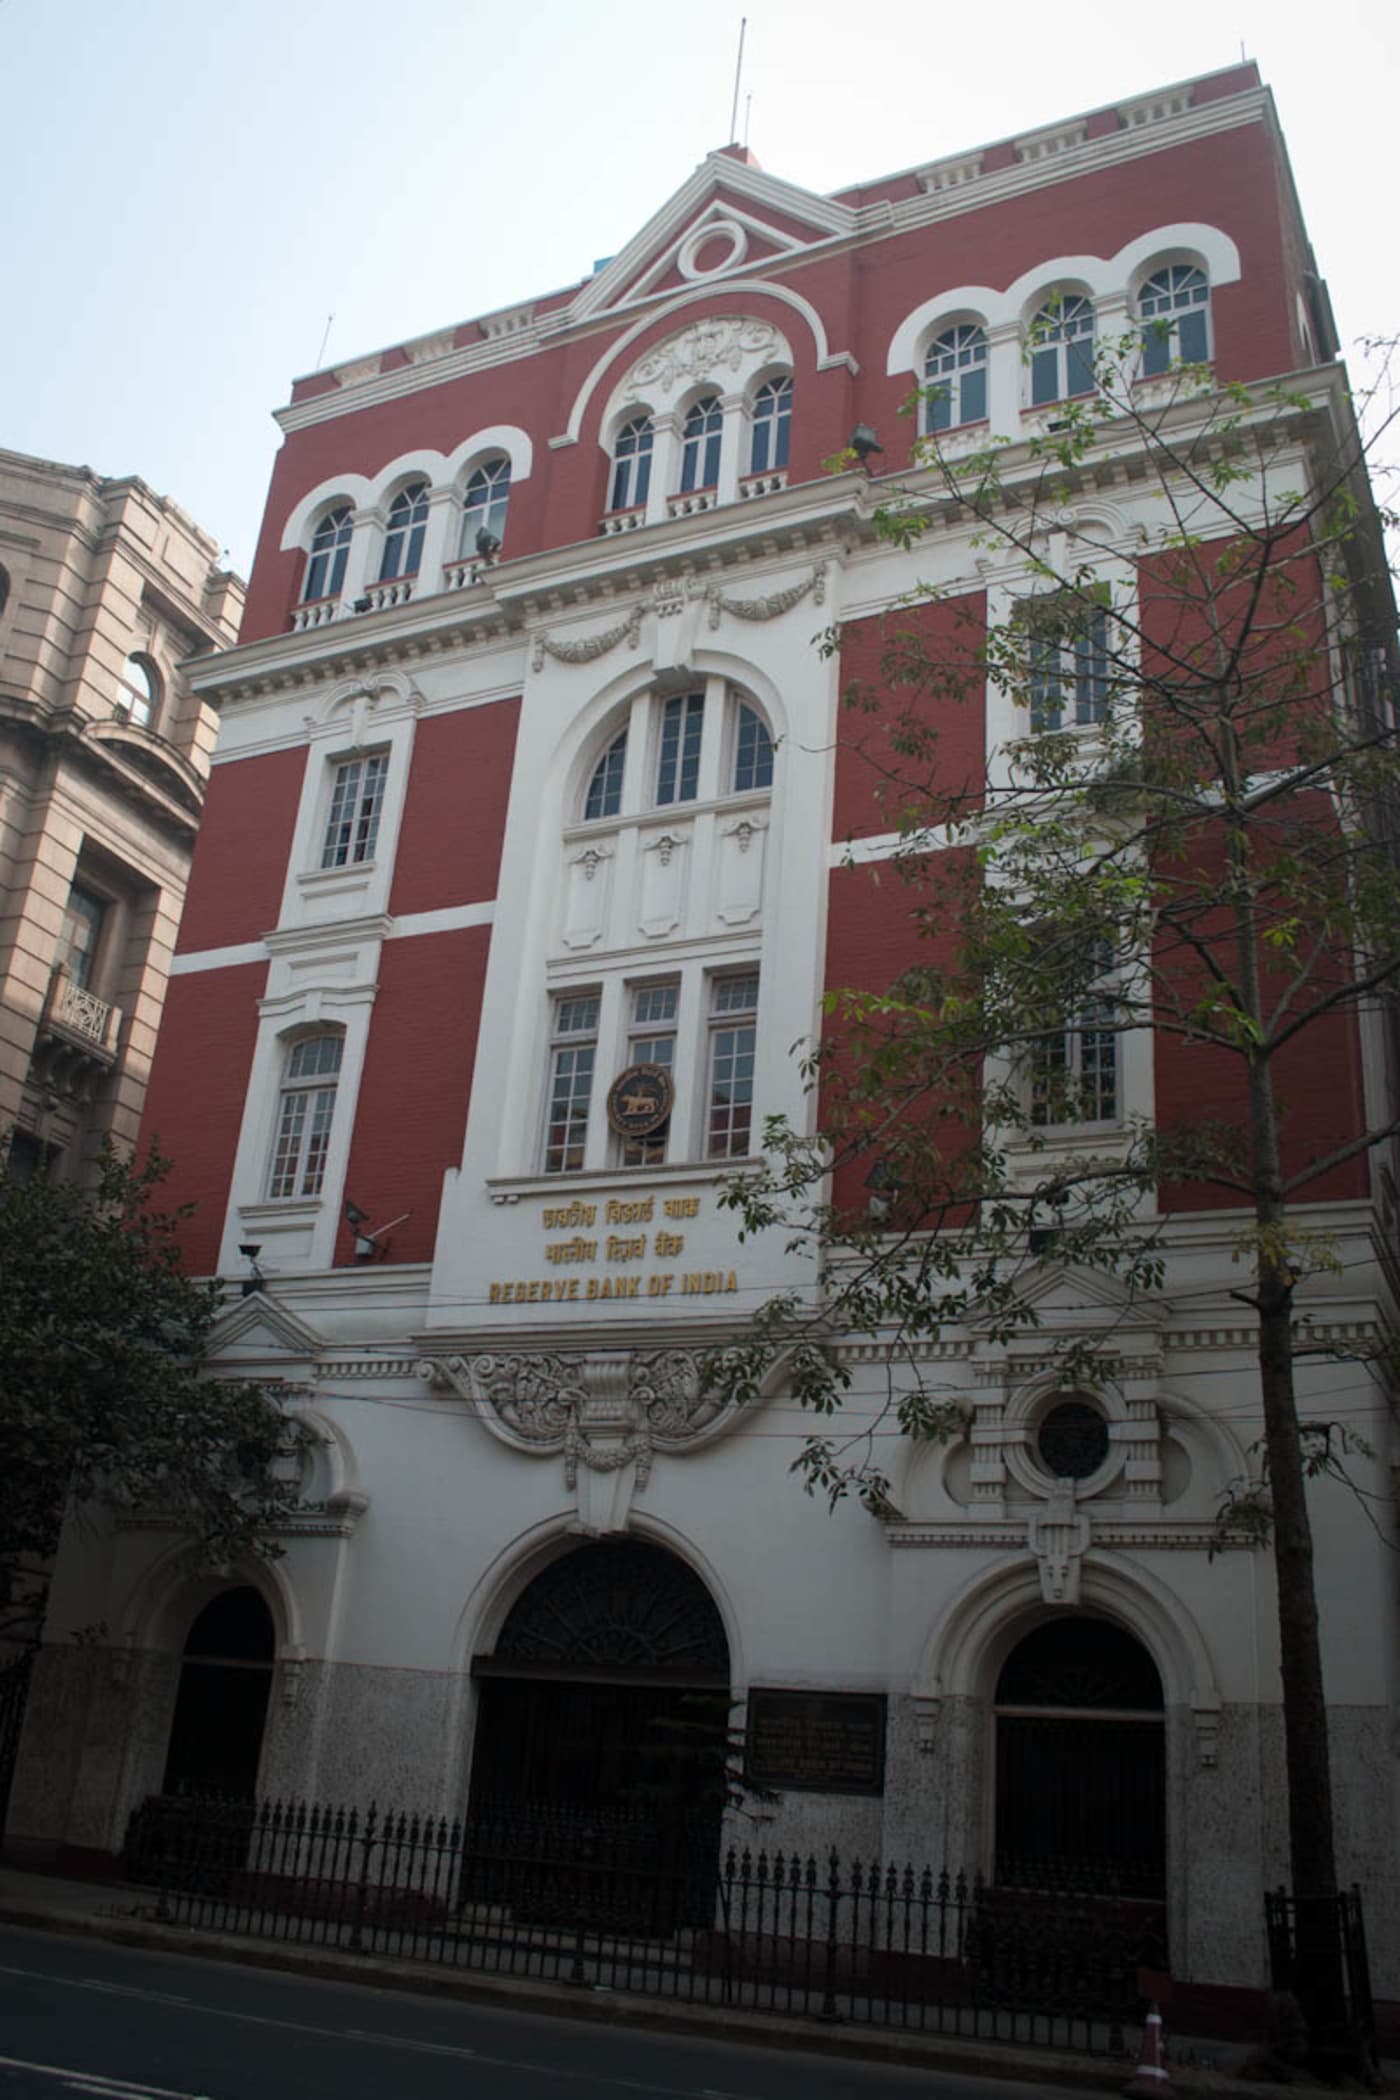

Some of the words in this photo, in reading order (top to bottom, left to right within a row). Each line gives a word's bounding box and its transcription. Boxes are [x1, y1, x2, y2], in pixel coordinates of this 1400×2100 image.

[546, 1237, 597, 1264] भारतीय
[655, 1231, 684, 1257] बैंक
[490, 1279, 580, 1303] RESERVE
[587, 1275, 641, 1299] BANK
[648, 1273, 674, 1296] OF
[681, 1270, 738, 1294] INDIA
